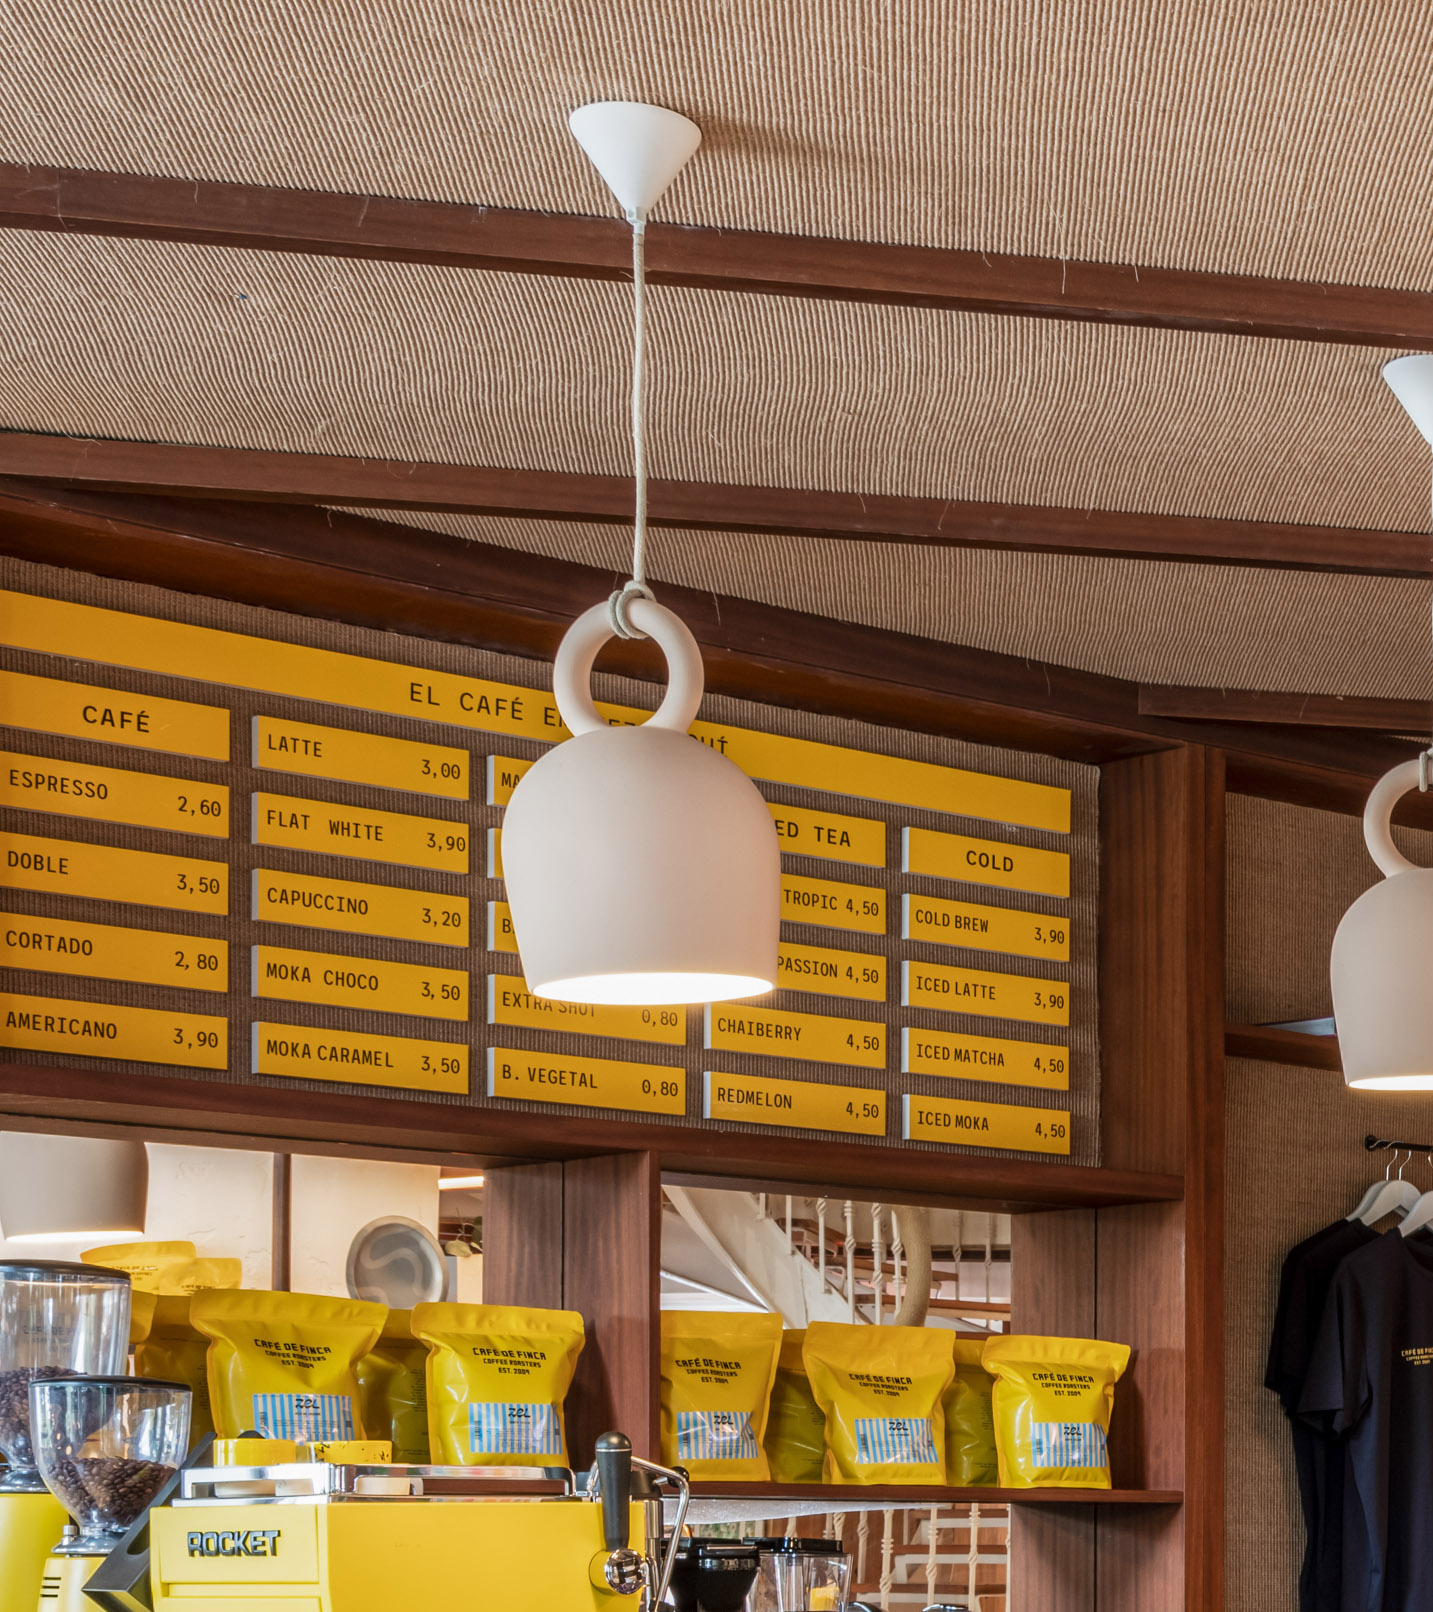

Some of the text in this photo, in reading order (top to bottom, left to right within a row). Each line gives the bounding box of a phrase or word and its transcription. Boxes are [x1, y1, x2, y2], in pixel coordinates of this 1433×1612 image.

[410, 682, 441, 706] EL
[459, 692, 523, 721] CAFÉ
[82, 705, 150, 733] CAFÉ
[267, 734, 461, 779] LATTE 3,00
[9, 769, 222, 817] ESPRESSO 2,60
[267, 809, 466, 852] FLAT WHITE 3,90
[814, 826, 851, 847] TEA
[7, 850, 220, 895] DOBLE 3,50
[966, 850, 1014, 872] COLD
[267, 887, 461, 928] CAPUCCINO 3,20
[784, 889, 879, 916] TROPIC 4,50
[916, 909, 1065, 945] COLD BREW 3,90
[5, 930, 219, 971] CORTADO 2,80
[266, 962, 460, 1001] MOKA CHOCO 3,50
[777, 956, 879, 984] PASSION 4,50
[502, 991, 553, 1012] EXTRA
[642, 1009, 678, 1027] 0,80
[916, 976, 1064, 1009] ICED LATTE 3,90
[6, 1011, 218, 1049] AMERICANO 3,90
[717, 1017, 880, 1051] CHAIBERRY 4,50
[266, 1039, 460, 1074] MOKA CARAMEL 3,50
[916, 1044, 1064, 1073] ICED MATCHA 4,50
[502, 1064, 679, 1097] B. VEGETAL 0,80
[717, 1087, 879, 1119] REDMELON 4,50
[917, 1110, 1066, 1139] ICED MOKA 4,50
[284, 1343, 299, 1351] DE
[300, 1344, 332, 1354] FINCA
[501, 1350, 515, 1358] DE
[517, 1351, 547, 1360] FINCA
[187, 1529, 280, 1558] ROCKET
